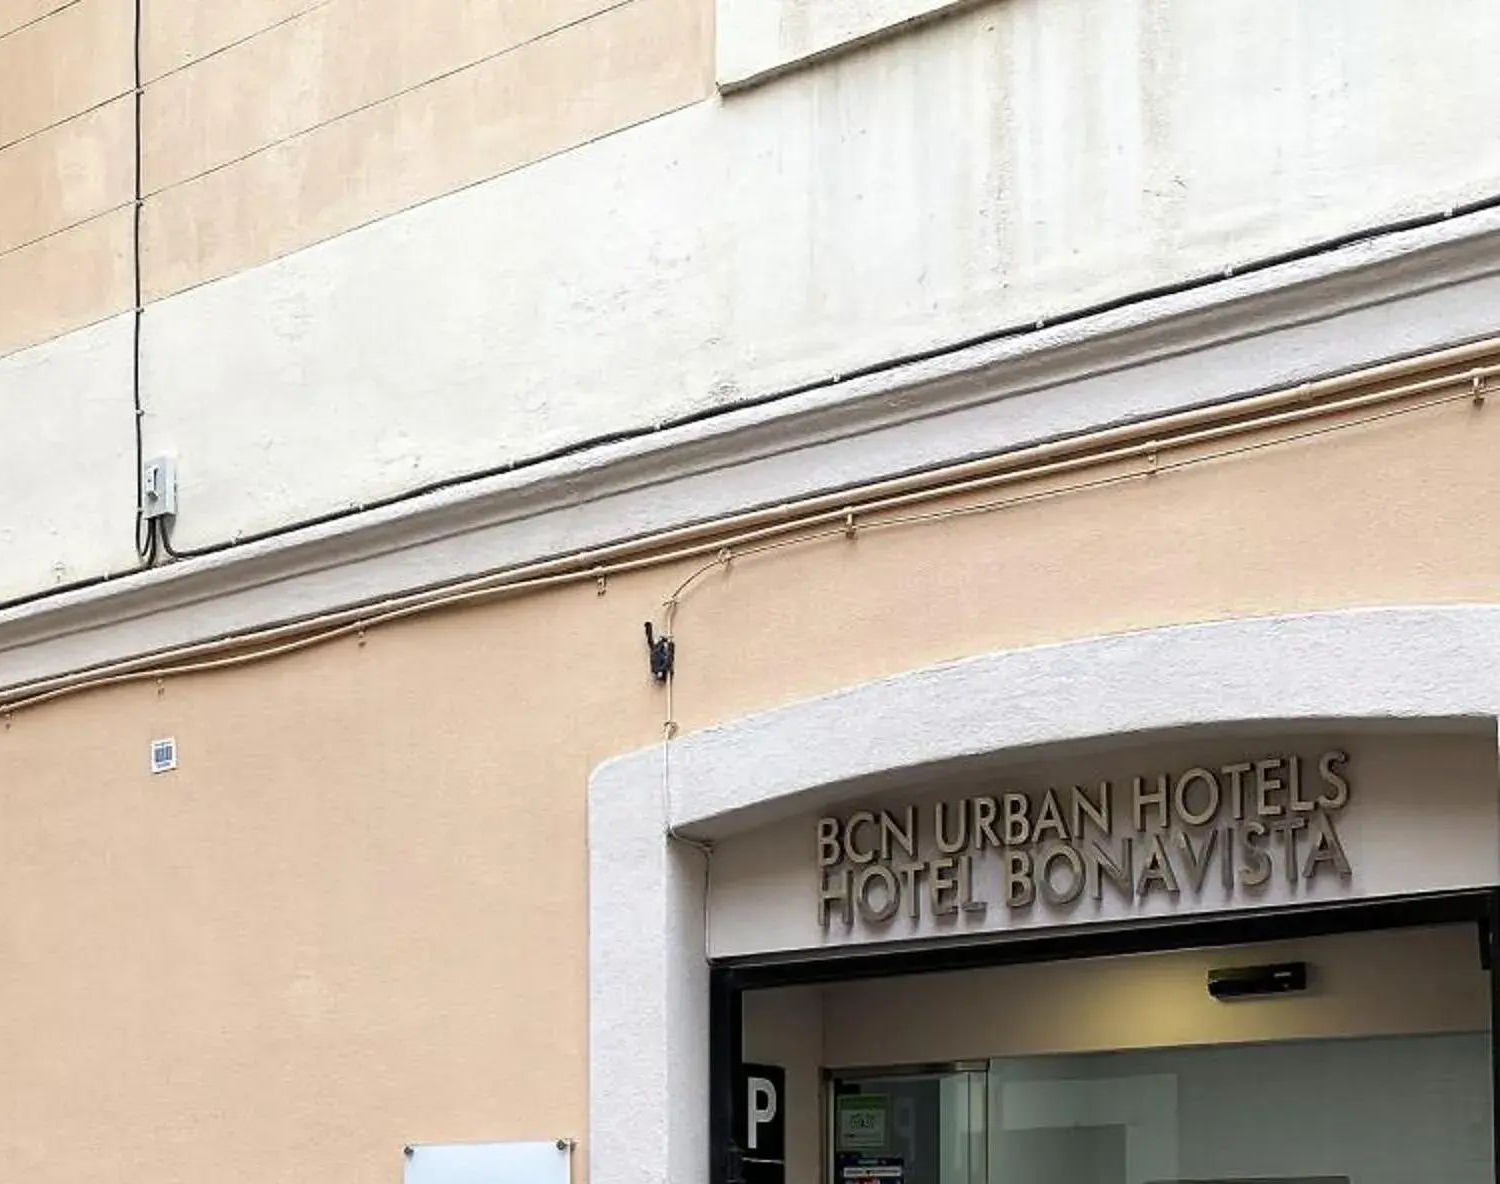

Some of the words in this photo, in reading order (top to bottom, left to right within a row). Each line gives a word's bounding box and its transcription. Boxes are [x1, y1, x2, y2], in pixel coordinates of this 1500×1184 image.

[817, 805, 917, 869] BCN
[934, 781, 1113, 854] URBAN
[1132, 750, 1349, 832] HOTELS
[818, 854, 990, 927] HOTEL
[1006, 812, 1353, 908] BONAVISTA
[747, 1076, 777, 1149] P
